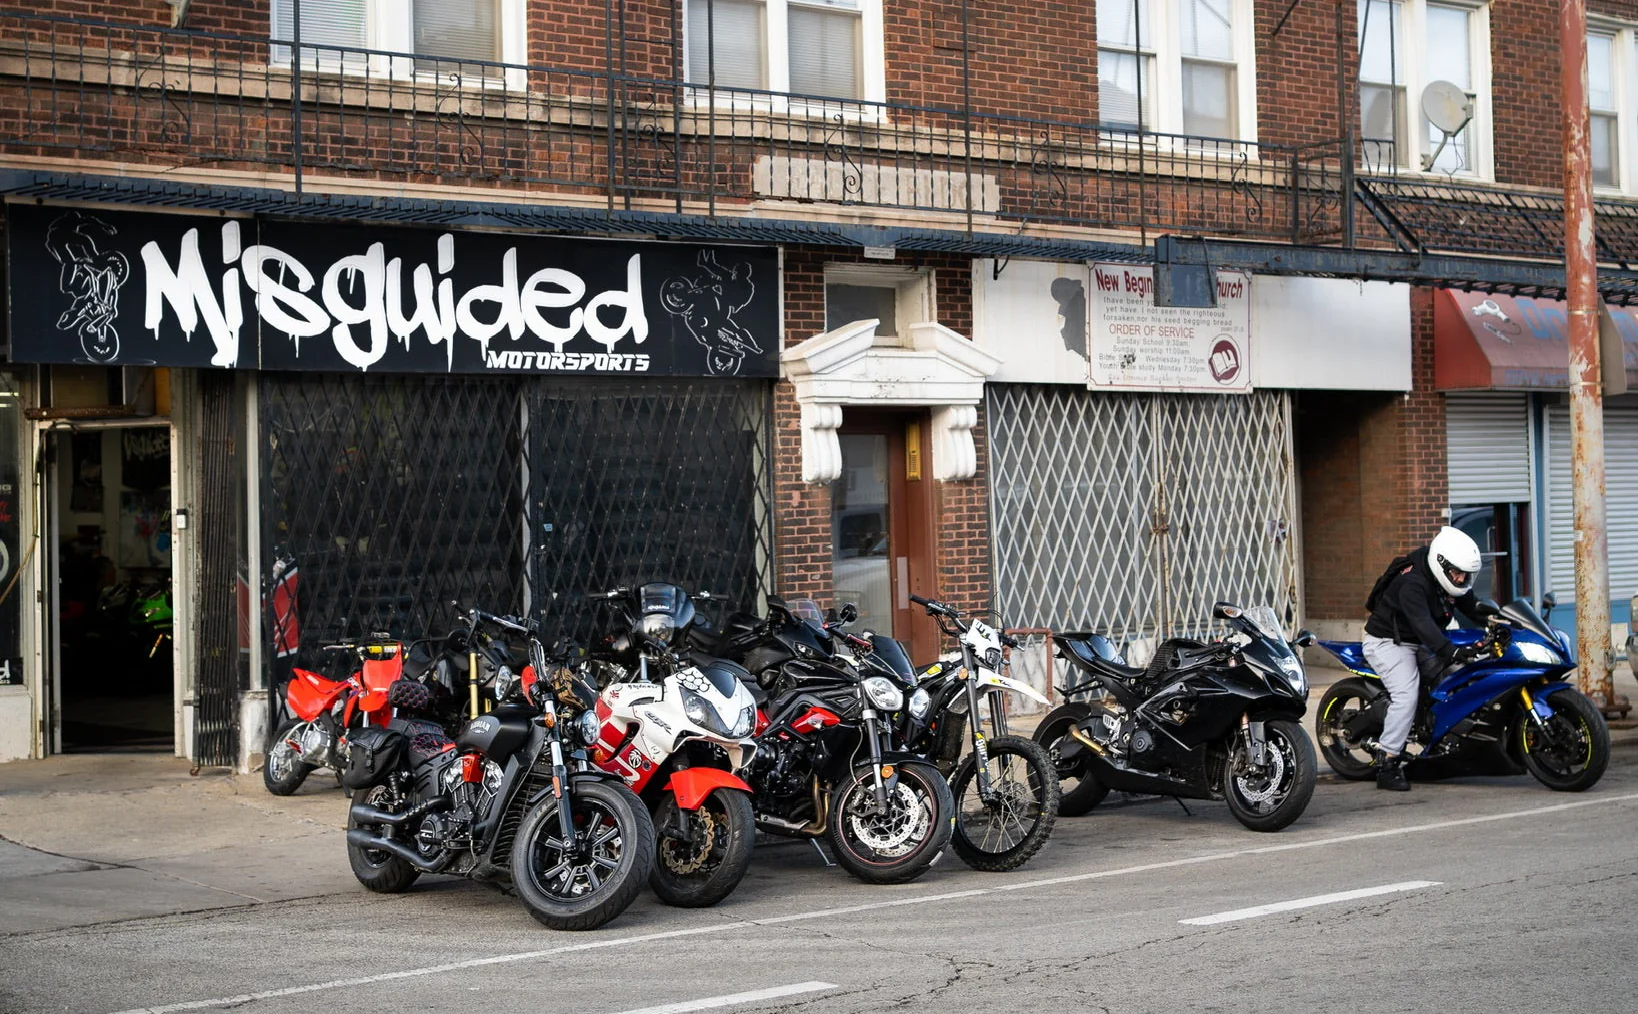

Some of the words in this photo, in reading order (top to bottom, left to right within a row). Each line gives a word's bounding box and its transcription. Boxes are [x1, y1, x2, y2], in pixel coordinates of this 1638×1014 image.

[1095, 269, 1119, 292] New
[1124, 270, 1154, 298] Begin
[1216, 277, 1243, 299] hurch
[142, 220, 649, 370] Misguided
[1126, 297, 1144, 305] been
[1193, 309, 1225, 319] righteous
[1183, 317, 1211, 327] begging
[1213, 318, 1233, 327] bread
[1109, 323, 1141, 335] ORDER
[1143, 325, 1157, 336] OF
[1158, 325, 1195, 339] SERVICE
[1116, 336, 1140, 346] Sunday
[1142, 338, 1164, 346] School
[1112, 345, 1136, 353] Sunday
[1139, 347, 1163, 356] worship
[487, 350, 651, 372] MOTORSPORTS
[1145, 354, 1180, 364] Wednesday
[1158, 364, 1181, 372] Monday
